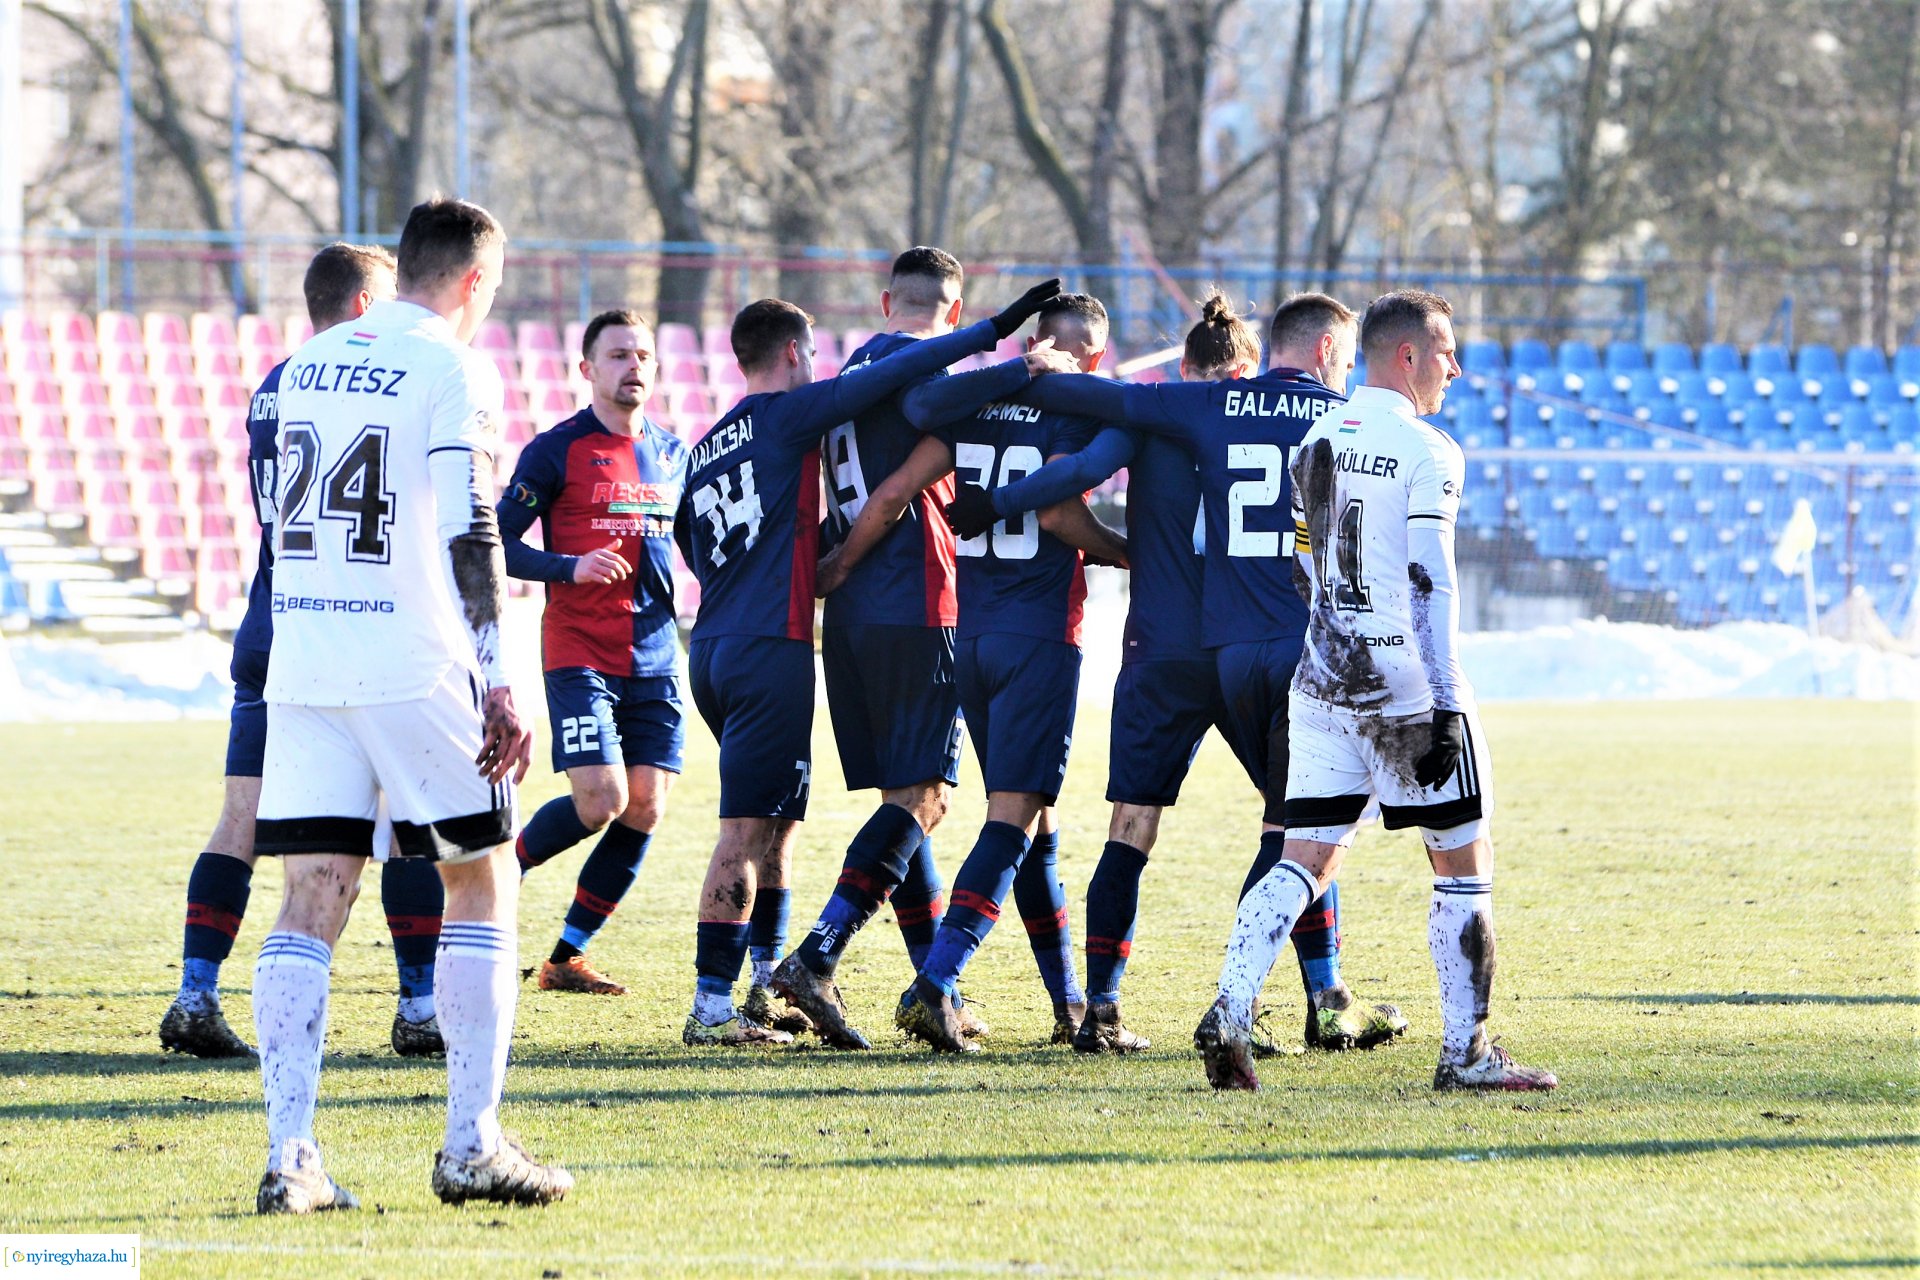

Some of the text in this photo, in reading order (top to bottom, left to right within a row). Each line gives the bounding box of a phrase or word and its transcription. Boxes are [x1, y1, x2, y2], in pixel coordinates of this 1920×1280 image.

[287, 358, 407, 398] SOLTÉSZ
[279, 421, 396, 564] 24
[692, 460, 764, 568] 74
[288, 597, 395, 613] BESTRONG
[562, 716, 600, 754] 22
